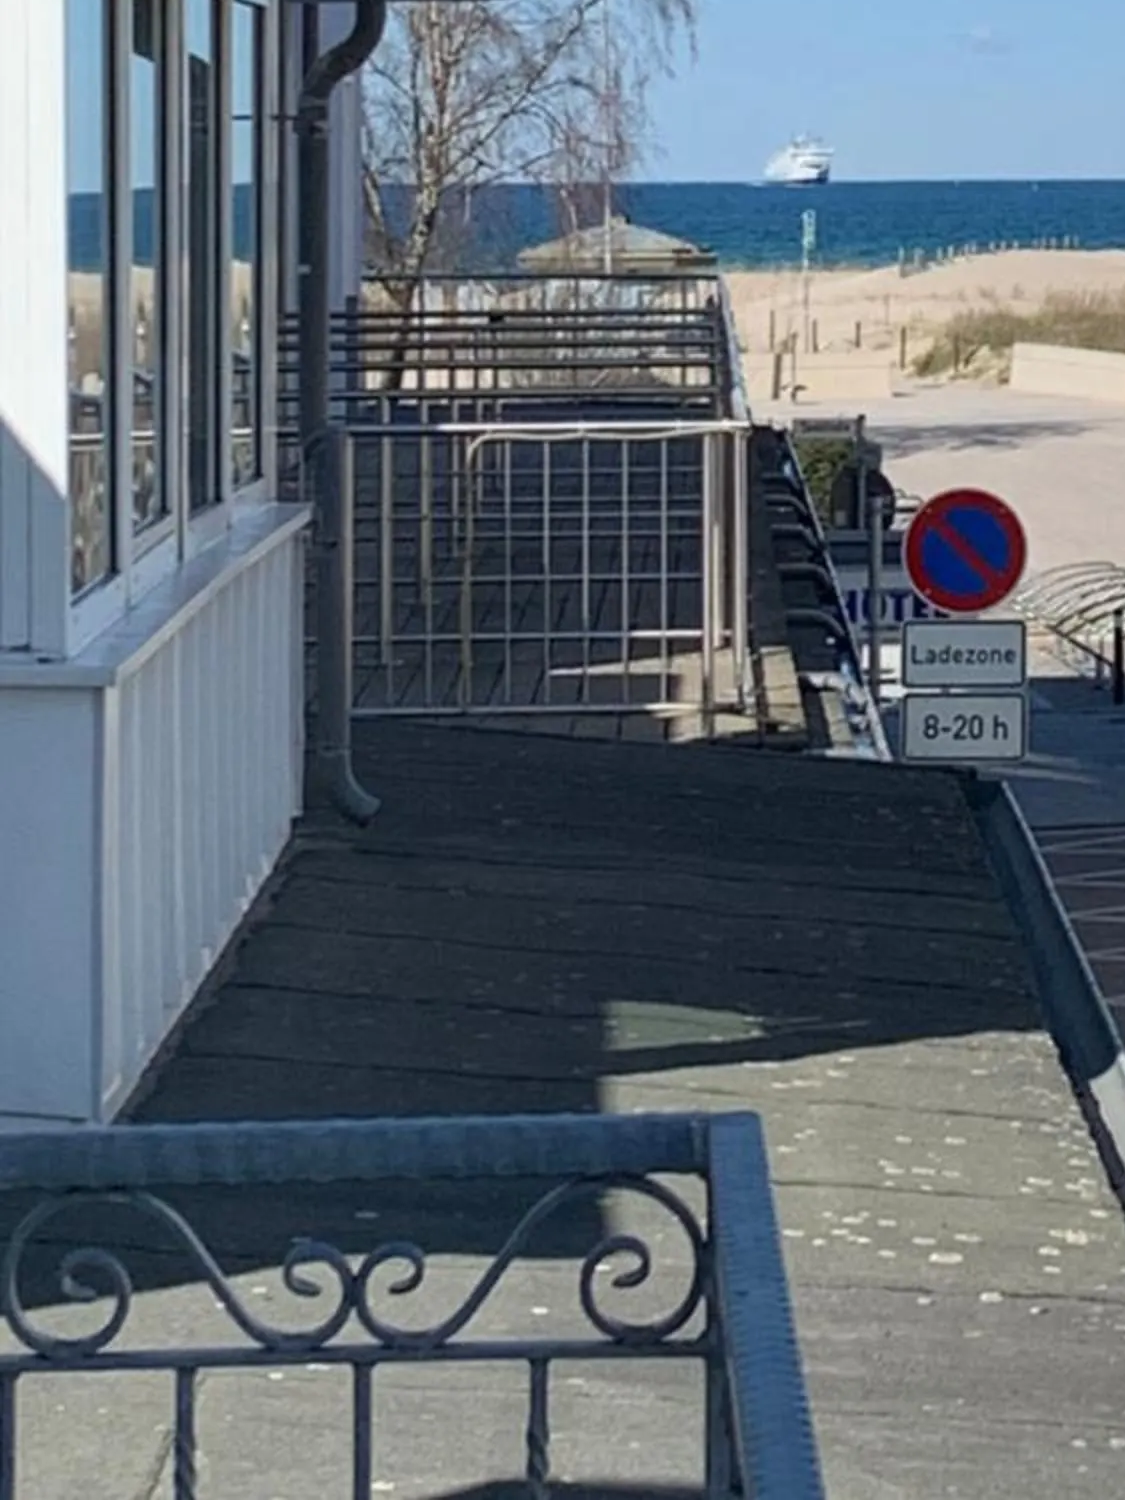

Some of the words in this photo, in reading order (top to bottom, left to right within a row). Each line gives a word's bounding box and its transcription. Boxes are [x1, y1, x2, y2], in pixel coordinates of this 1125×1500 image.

[910, 644, 1017, 666] Ladezone
[922, 714, 984, 741] 8-20
[992, 714, 1009, 741] h
